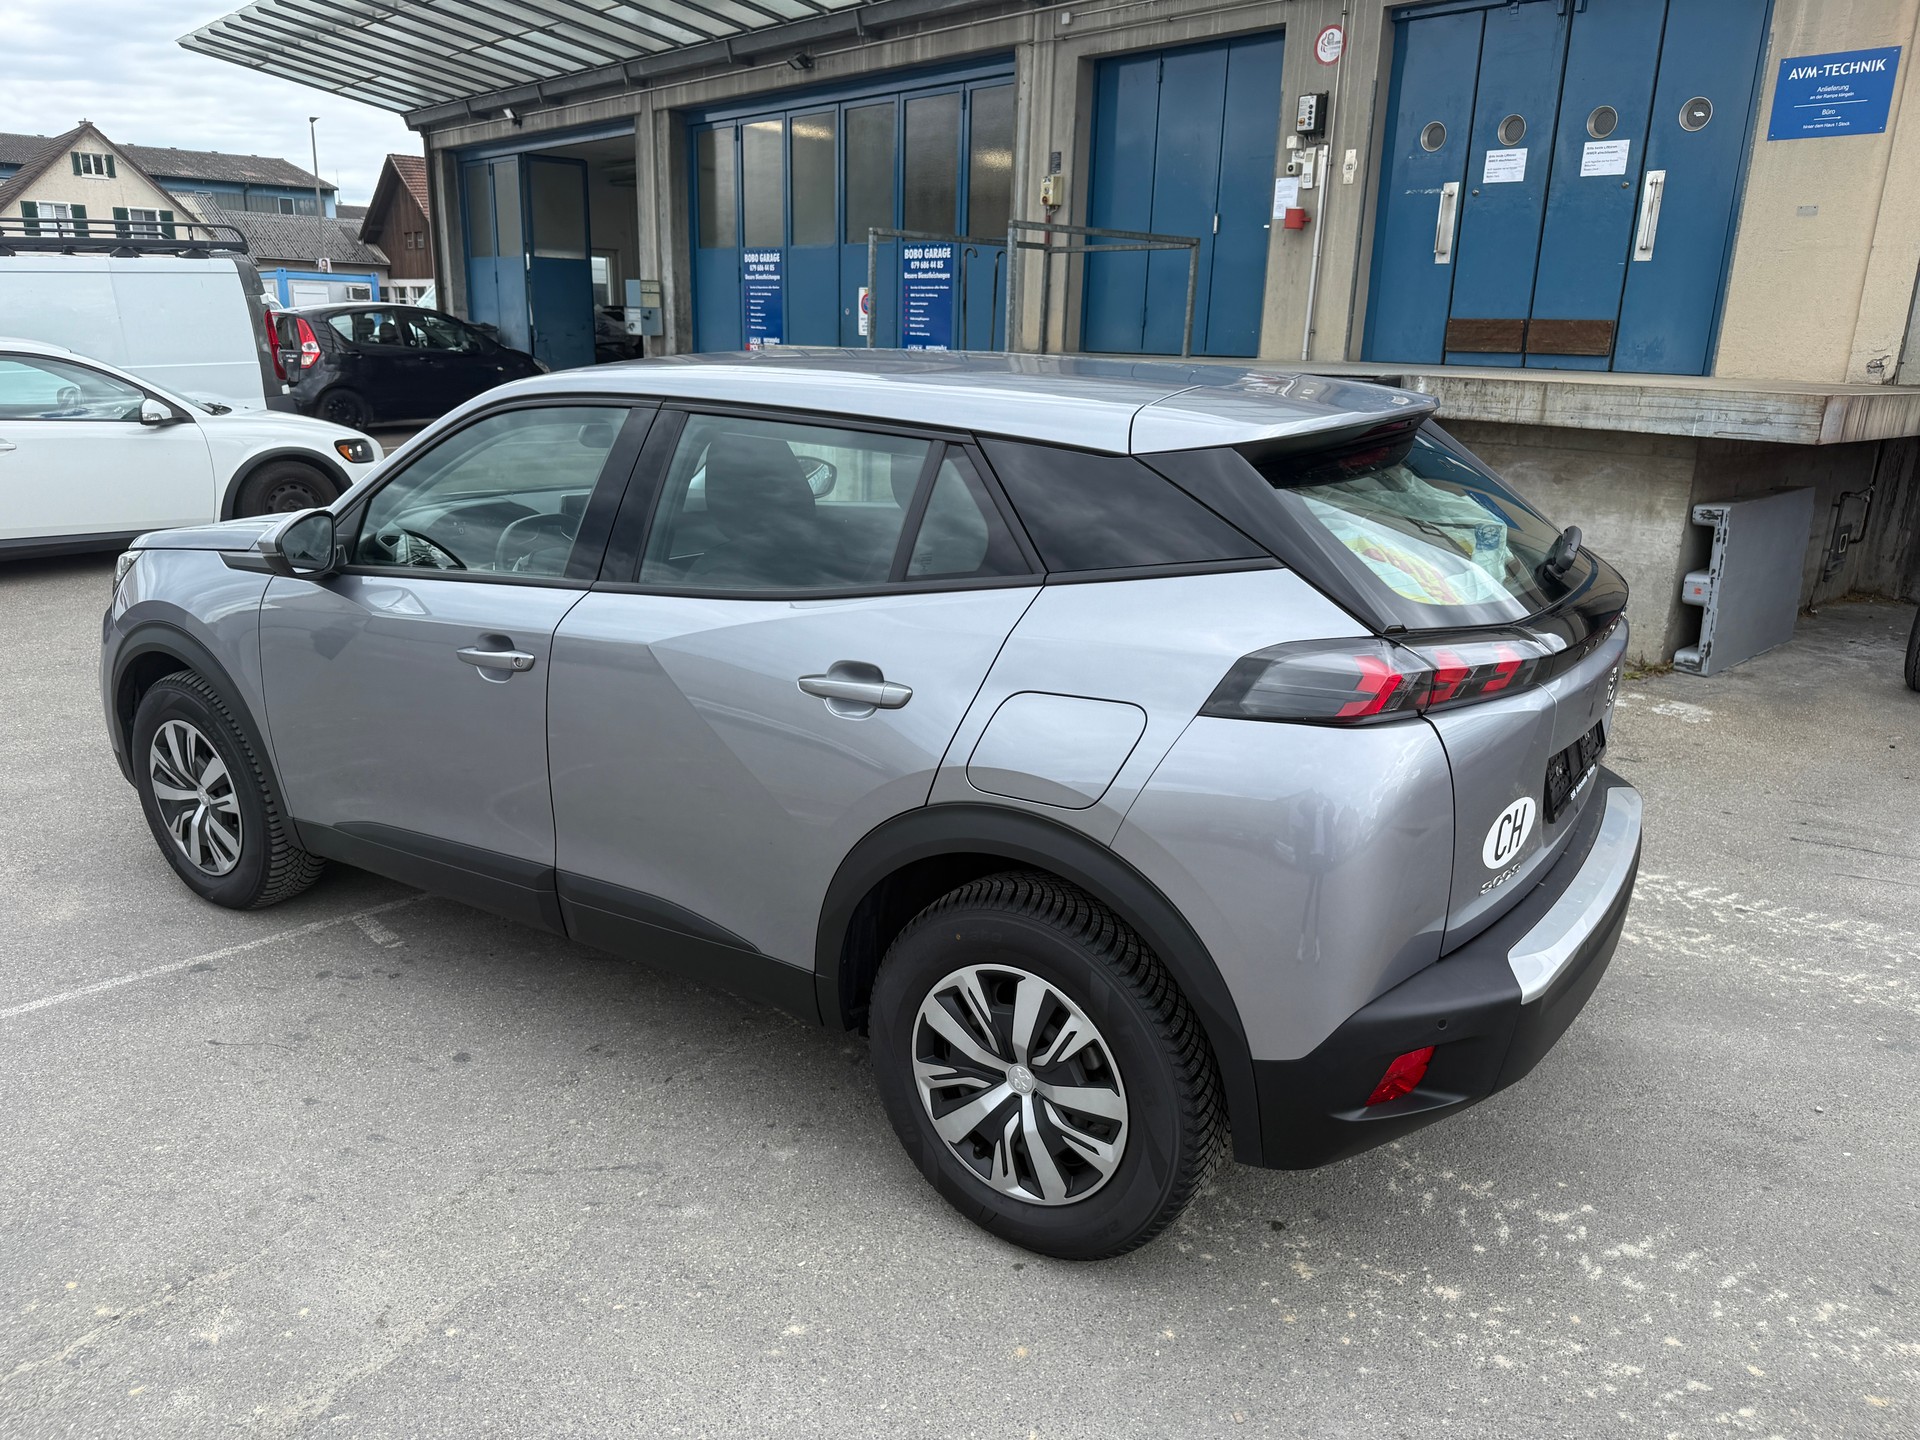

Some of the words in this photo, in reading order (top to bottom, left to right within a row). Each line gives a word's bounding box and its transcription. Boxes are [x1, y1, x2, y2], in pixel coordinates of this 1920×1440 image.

[1788, 58, 1887, 80] AVM-TECHNIK
[1816, 85, 1850, 93] Anlieferung
[744, 253, 759, 262] BOBO
[760, 252, 780, 262] GARAGE
[904, 248, 923, 260] BOBO
[924, 247, 952, 259] GARAGE
[910, 260, 920, 269] 079
[930, 260, 936, 268] 44
[1494, 803, 1527, 861] CH
